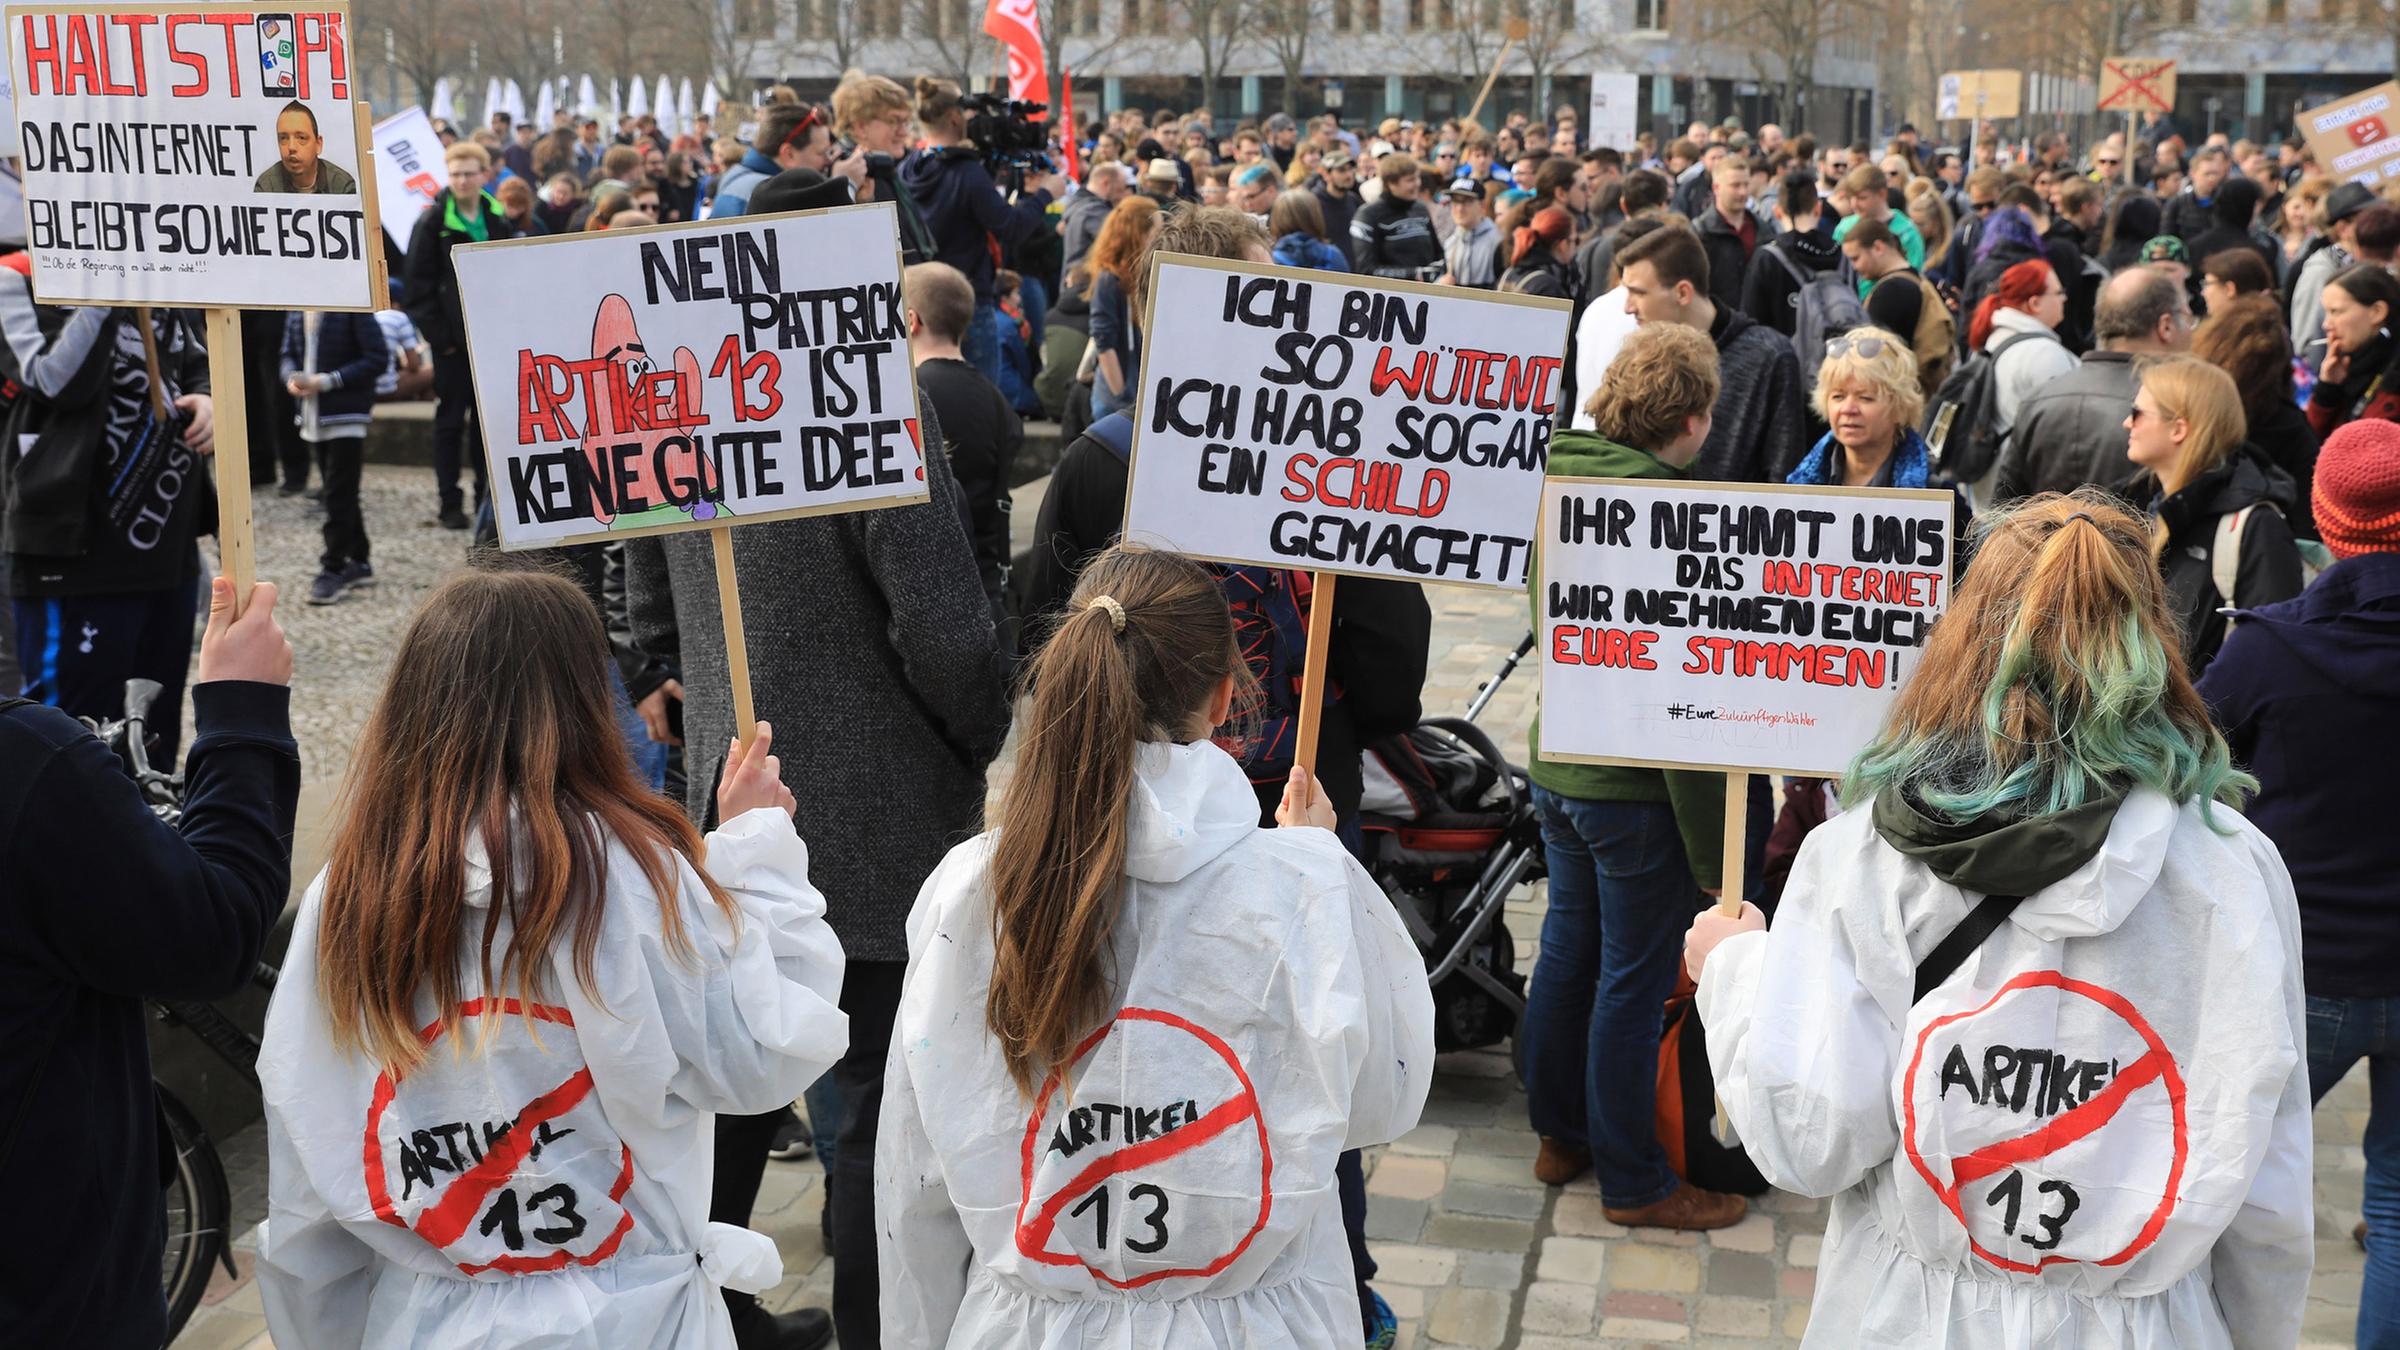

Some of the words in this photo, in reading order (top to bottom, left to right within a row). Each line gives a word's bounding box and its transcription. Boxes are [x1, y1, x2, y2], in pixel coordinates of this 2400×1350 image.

[29, 200, 152, 254] BLEIBT
[80, 257, 126, 278] Regierung
[640, 229, 781, 304] NEIN
[731, 281, 907, 352] PATRICK
[1223, 275, 1312, 333] ICH
[1338, 290, 1428, 345] BIN
[518, 348, 711, 445] ARTIKEL
[708, 334, 784, 423] 13
[809, 342, 892, 419] IST
[1260, 332, 1354, 390] SO
[1152, 377, 1241, 441] ICH
[1251, 387, 1364, 457] HAB
[1386, 405, 1554, 474] SOGAR
[652, 430, 785, 506] GUTE
[1198, 443, 1268, 496] EIN
[1280, 453, 1451, 518] SCHILD
[1559, 495, 1636, 548] IHR
[1650, 500, 1836, 558] NEHMT
[1852, 512, 1945, 567] UNS
[1676, 554, 1744, 591] DAS
[1548, 581, 1613, 623] WIR
[1624, 588, 1814, 636] NEHMEN
[1552, 624, 1660, 671] EURE
[1941, 1043, 2119, 1118] ARTIKE
[480, 1182, 588, 1251] 13
[1071, 1183, 1169, 1253] 13
[1986, 1169, 2081, 1250] 13
